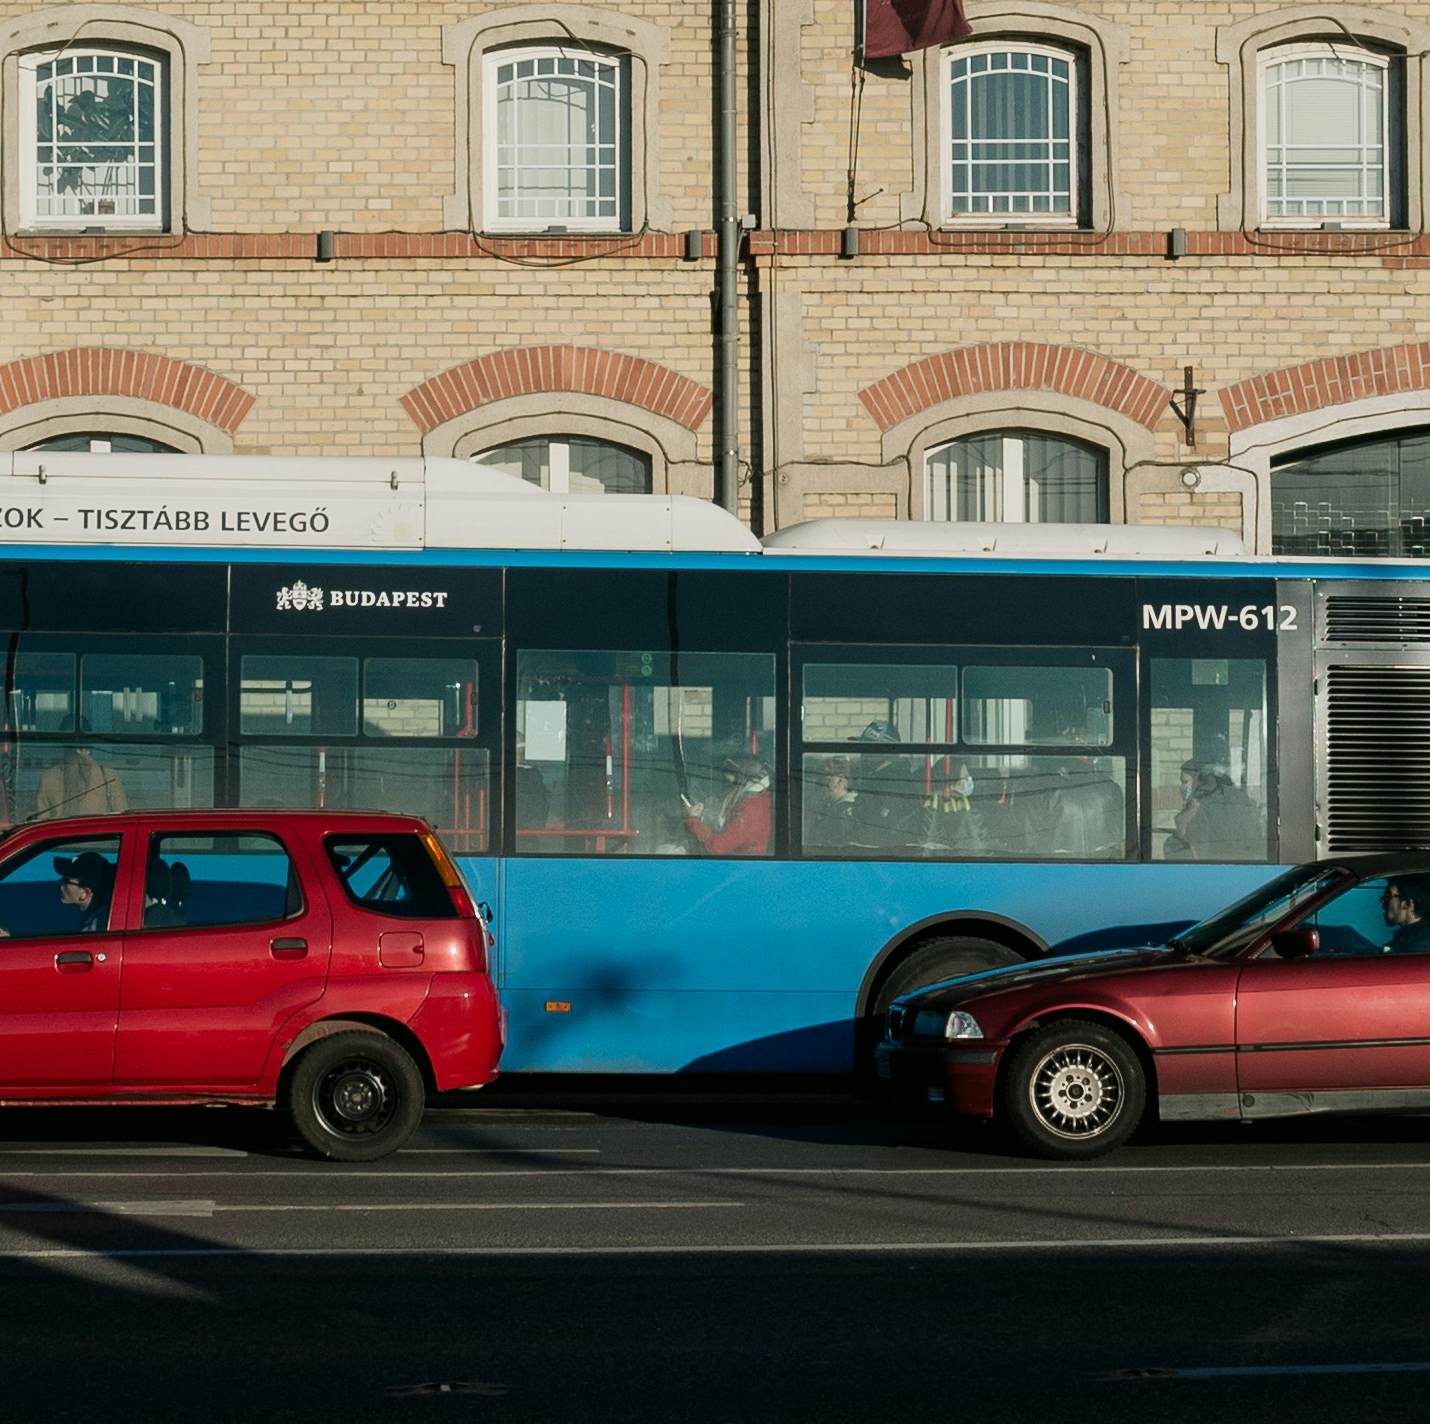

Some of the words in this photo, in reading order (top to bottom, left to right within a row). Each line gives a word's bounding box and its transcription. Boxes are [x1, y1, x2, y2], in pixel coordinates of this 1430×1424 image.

[78, 504, 210, 531] TISZTÁBB
[221, 506, 330, 533] LEVEGŐ
[329, 590, 448, 608] BUDAPEST
[1142, 604, 1298, 631] MPW-612
